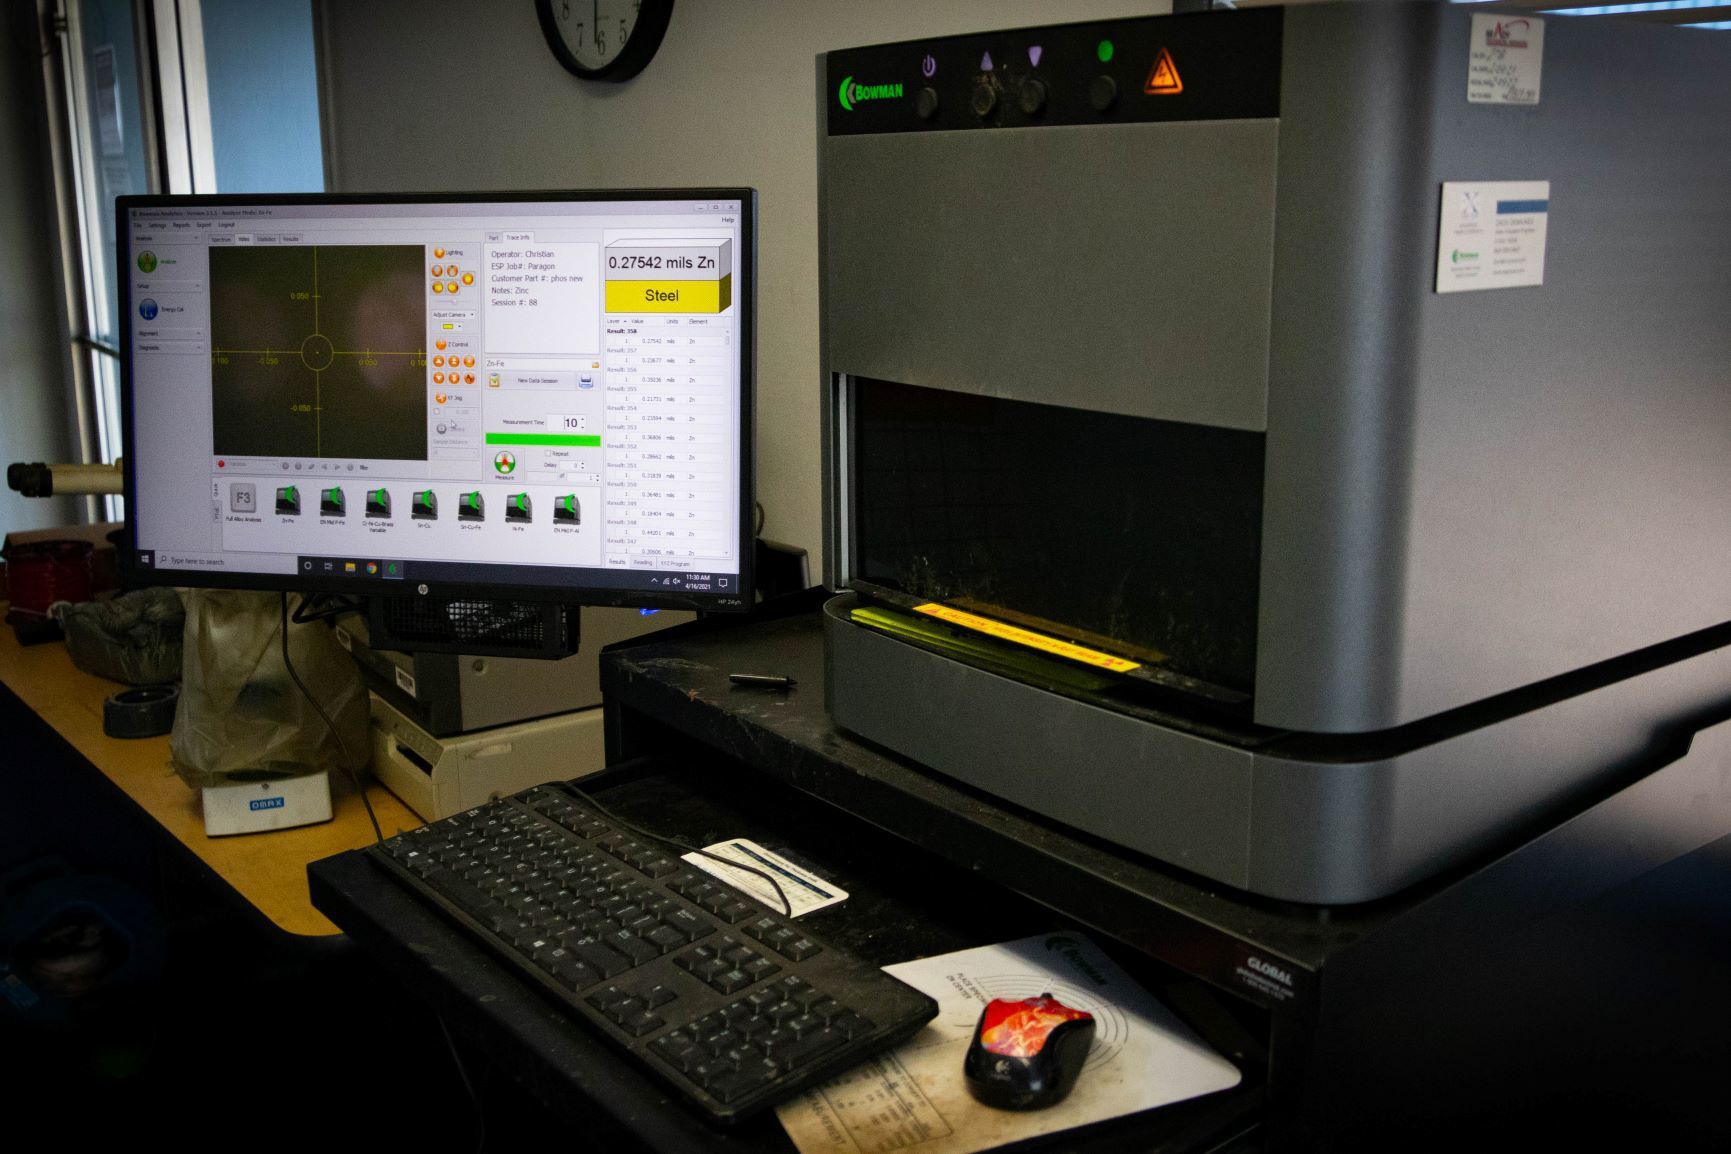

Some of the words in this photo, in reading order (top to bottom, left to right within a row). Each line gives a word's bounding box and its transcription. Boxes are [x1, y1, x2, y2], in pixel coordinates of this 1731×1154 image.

[577, 23, 583, 47] 7
[620, 19, 627, 44] 5
[598, 30, 605, 55] 6
[856, 83, 903, 101] BOWMAN
[608, 256, 662, 268] 0.27542
[666, 256, 693, 268] mils
[697, 256, 715, 268] Zn
[645, 289, 679, 301] Steel
[565, 418, 577, 428] 10
[236, 492, 250, 504] F3
[171, 557, 184, 565] Type
[1248, 957, 1292, 986] GLOBAL
